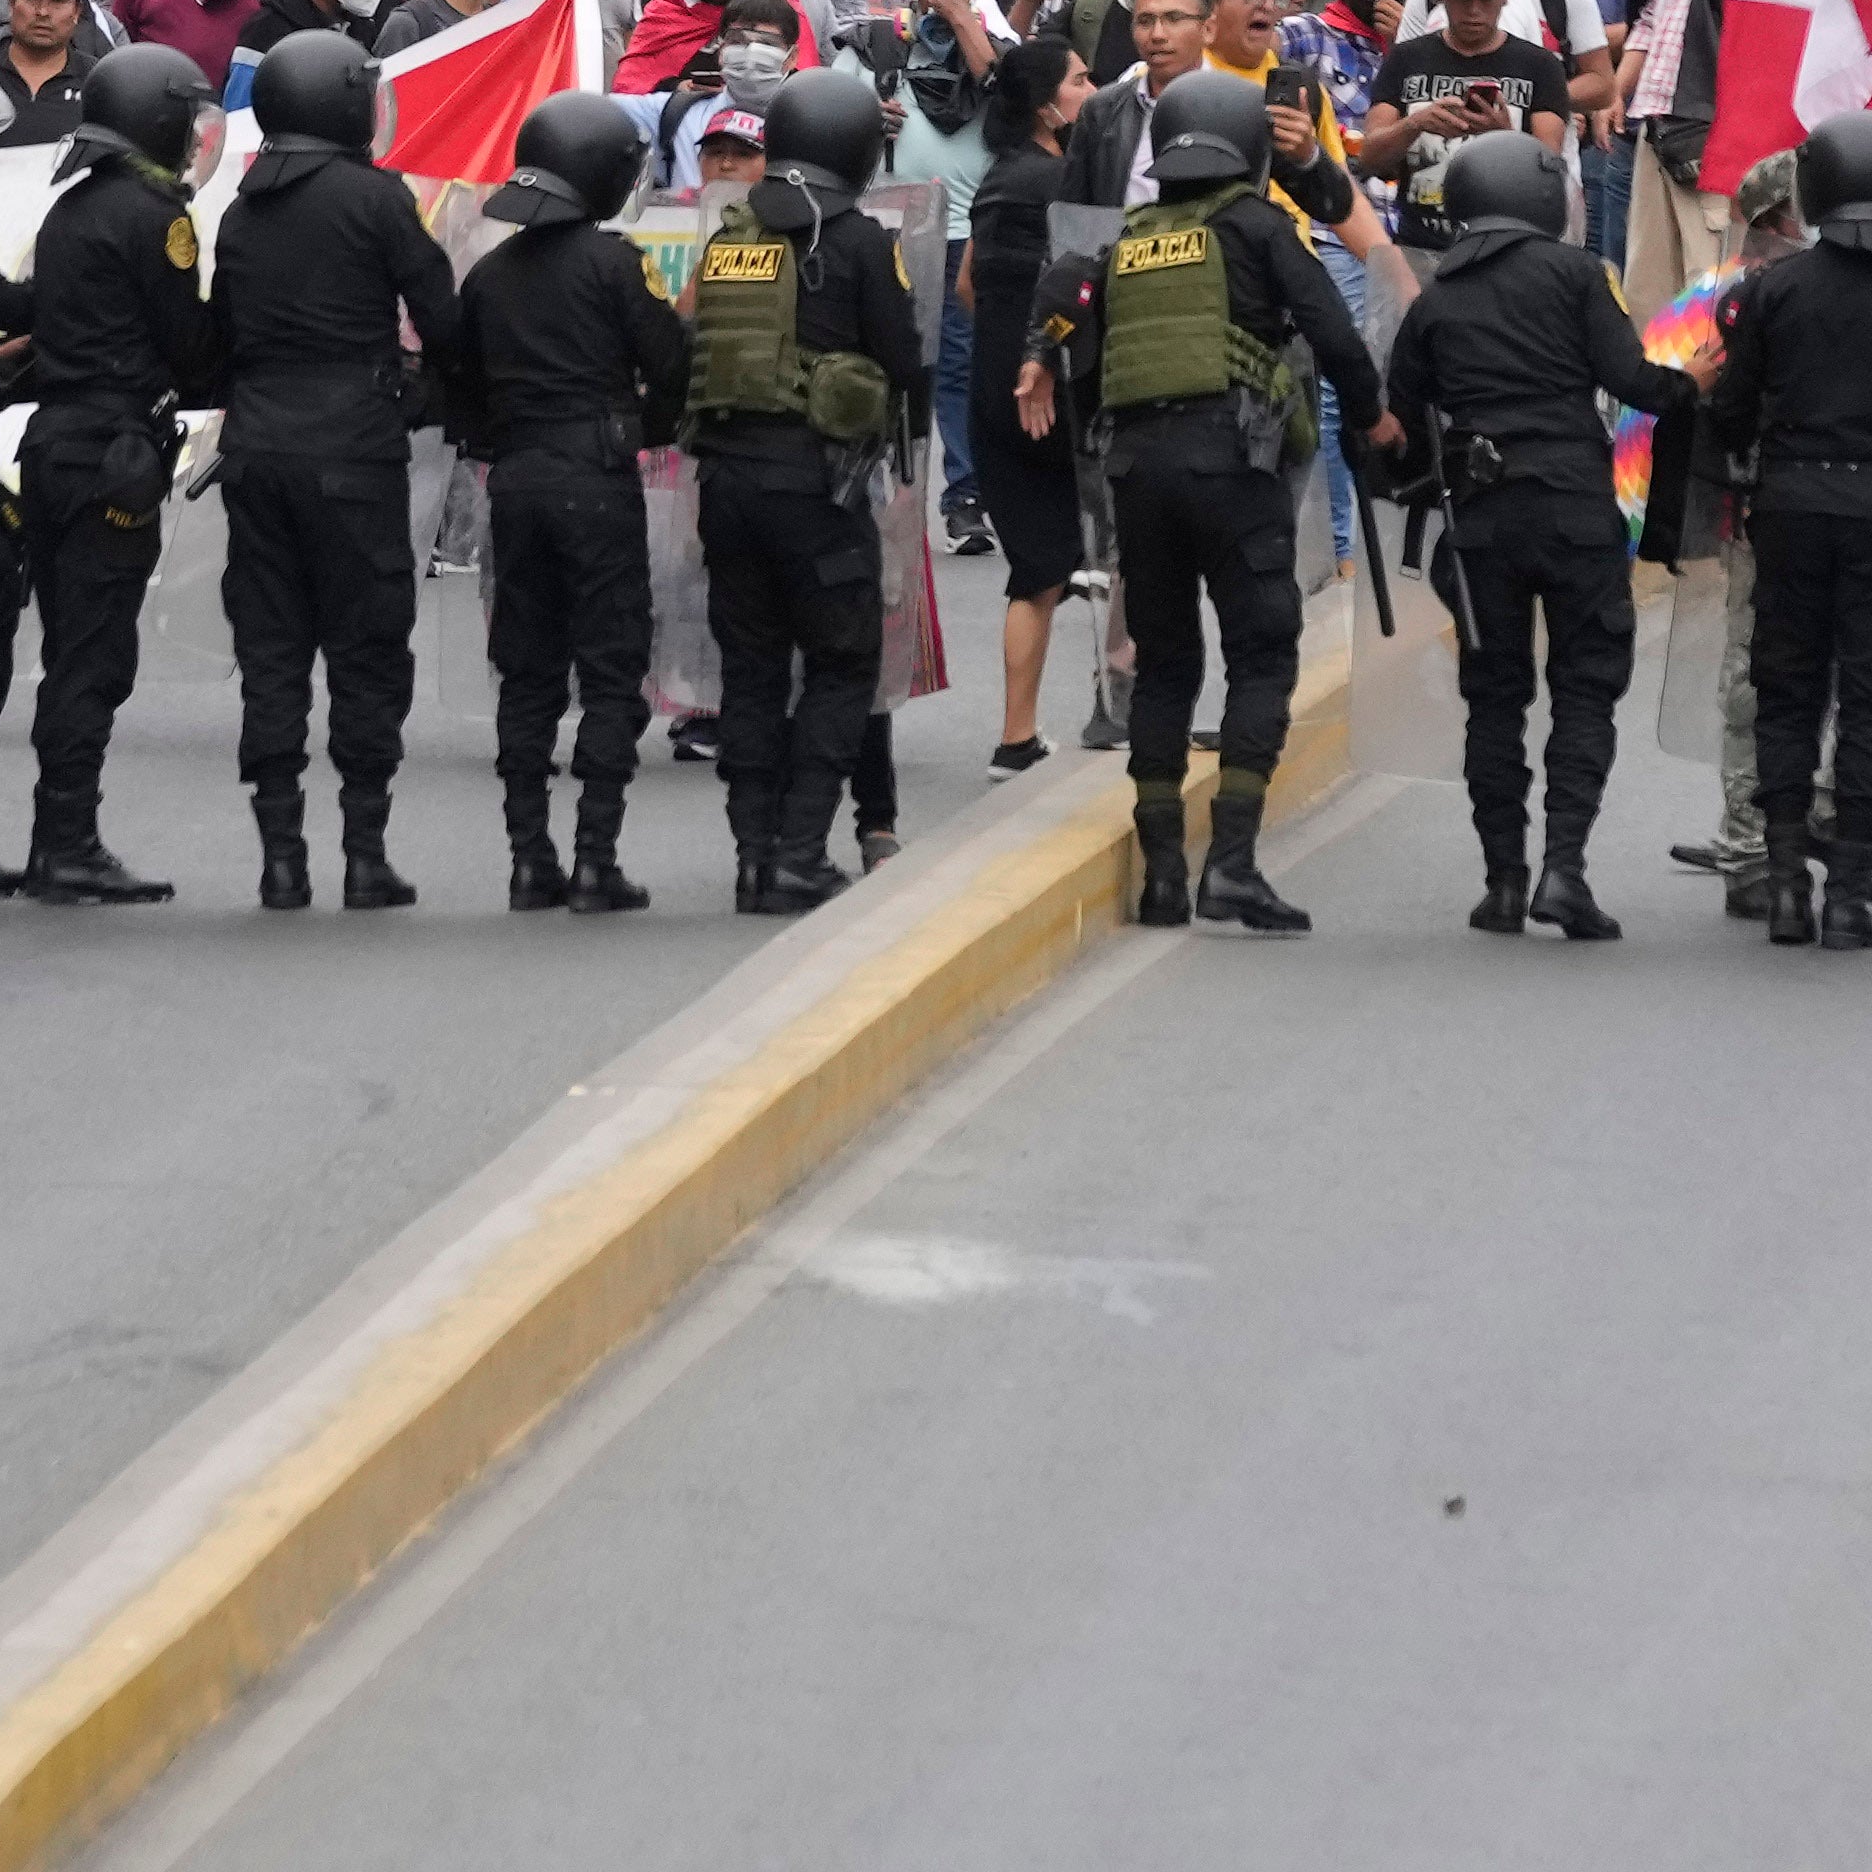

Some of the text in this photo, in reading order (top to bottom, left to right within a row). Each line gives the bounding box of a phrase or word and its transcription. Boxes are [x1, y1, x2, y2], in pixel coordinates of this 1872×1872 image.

[1431, 76, 1533, 109] PAON
[707, 248, 778, 277] POLICIA
[1118, 230, 1203, 271] POLICIA
